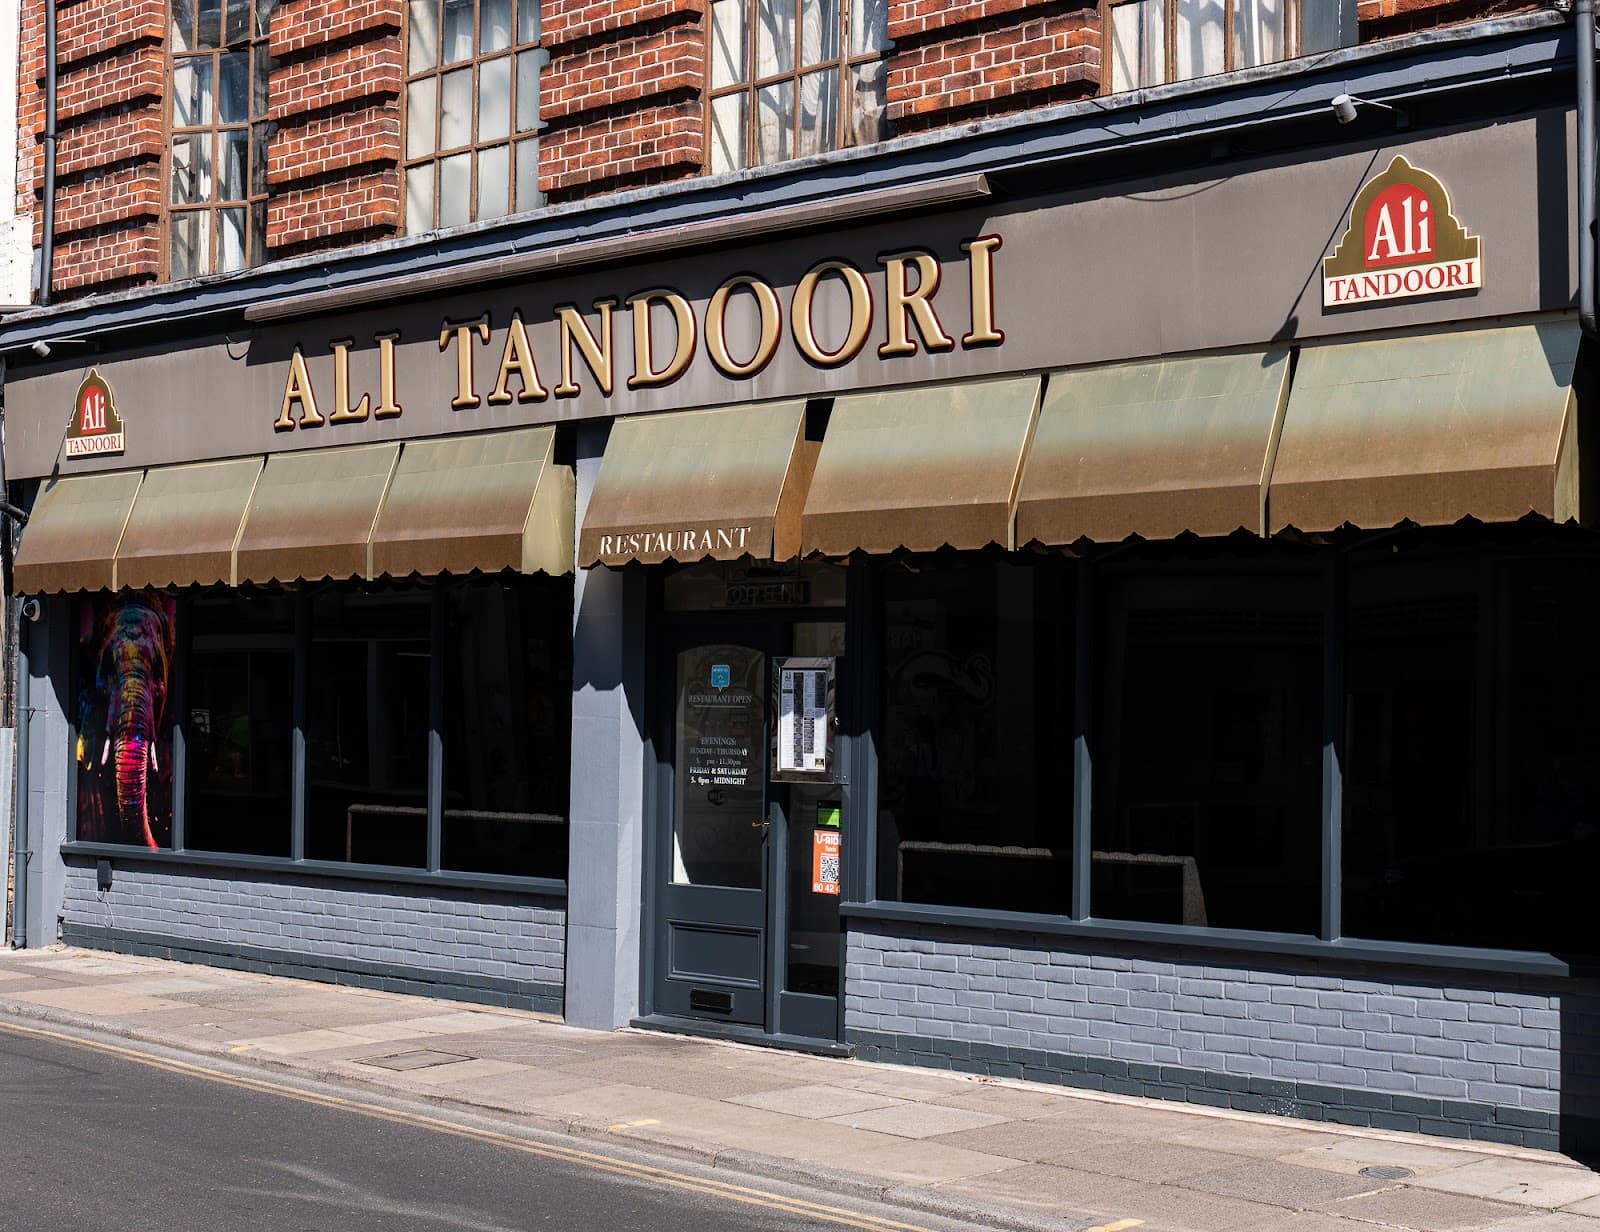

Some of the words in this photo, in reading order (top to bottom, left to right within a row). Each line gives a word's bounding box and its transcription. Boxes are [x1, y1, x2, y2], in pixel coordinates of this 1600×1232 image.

[1367, 196, 1432, 261] Ali
[1329, 261, 1475, 302] TANDOORI
[273, 331, 402, 432] ALI
[439, 233, 1005, 411] TANDOORI
[81, 393, 107, 431] Ali
[68, 435, 121, 454] TANDOORI
[598, 526, 752, 555] RESTAURANT
[688, 695, 731, 704] RESTAURANT
[732, 695, 752, 704] OPEN
[711, 767, 717, 775] &
[717, 767, 748, 775] SATURDAY
[713, 777, 746, 785] MIDNIGHT
